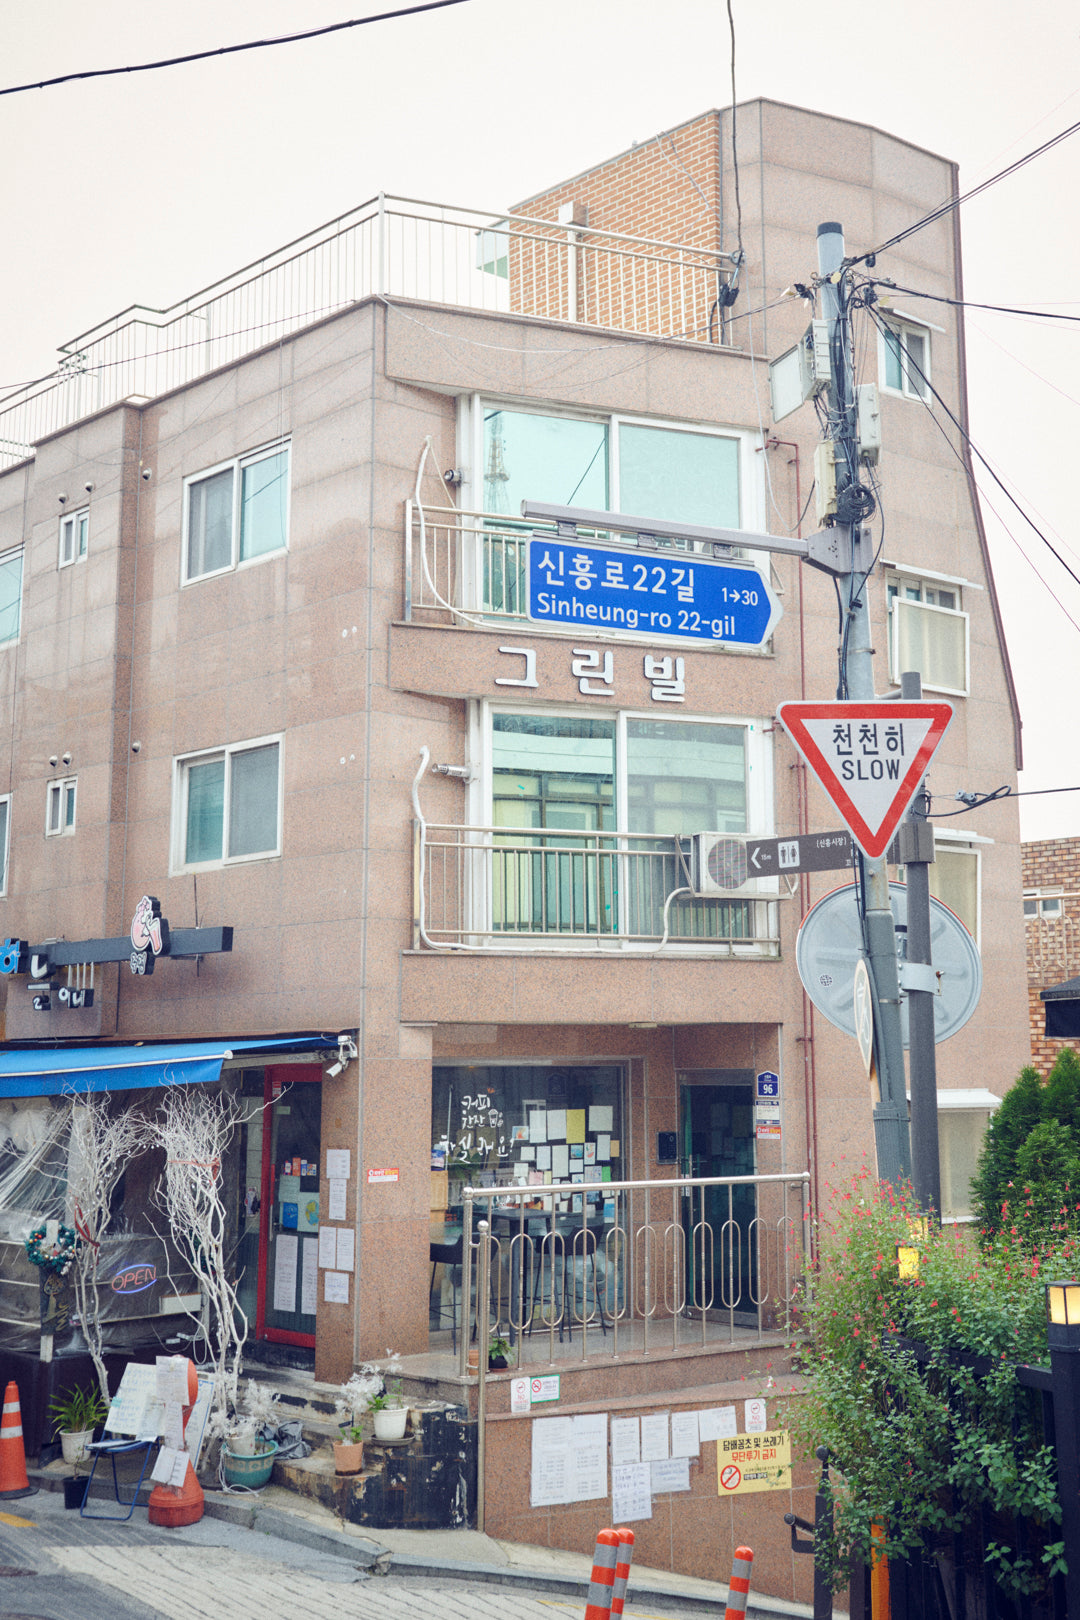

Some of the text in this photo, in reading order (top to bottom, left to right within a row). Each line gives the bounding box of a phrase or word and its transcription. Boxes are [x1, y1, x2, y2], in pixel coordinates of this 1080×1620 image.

[538, 551, 694, 603] 신흥로22길
[537, 592, 735, 638] Sinheung-ro 22-gil
[494, 646, 686, 703] 그린빌
[832, 723, 904, 756] 천천히
[841, 759, 900, 780] SLOW
[762, 1083, 774, 1094] 96
[460, 1093, 491, 1111] 커피
[111, 1266, 157, 1291] OPEN
[723, 1435, 784, 1452] 담배꽁초 및 쓰레기
[731, 1448, 777, 1463] 무단투기 금지
